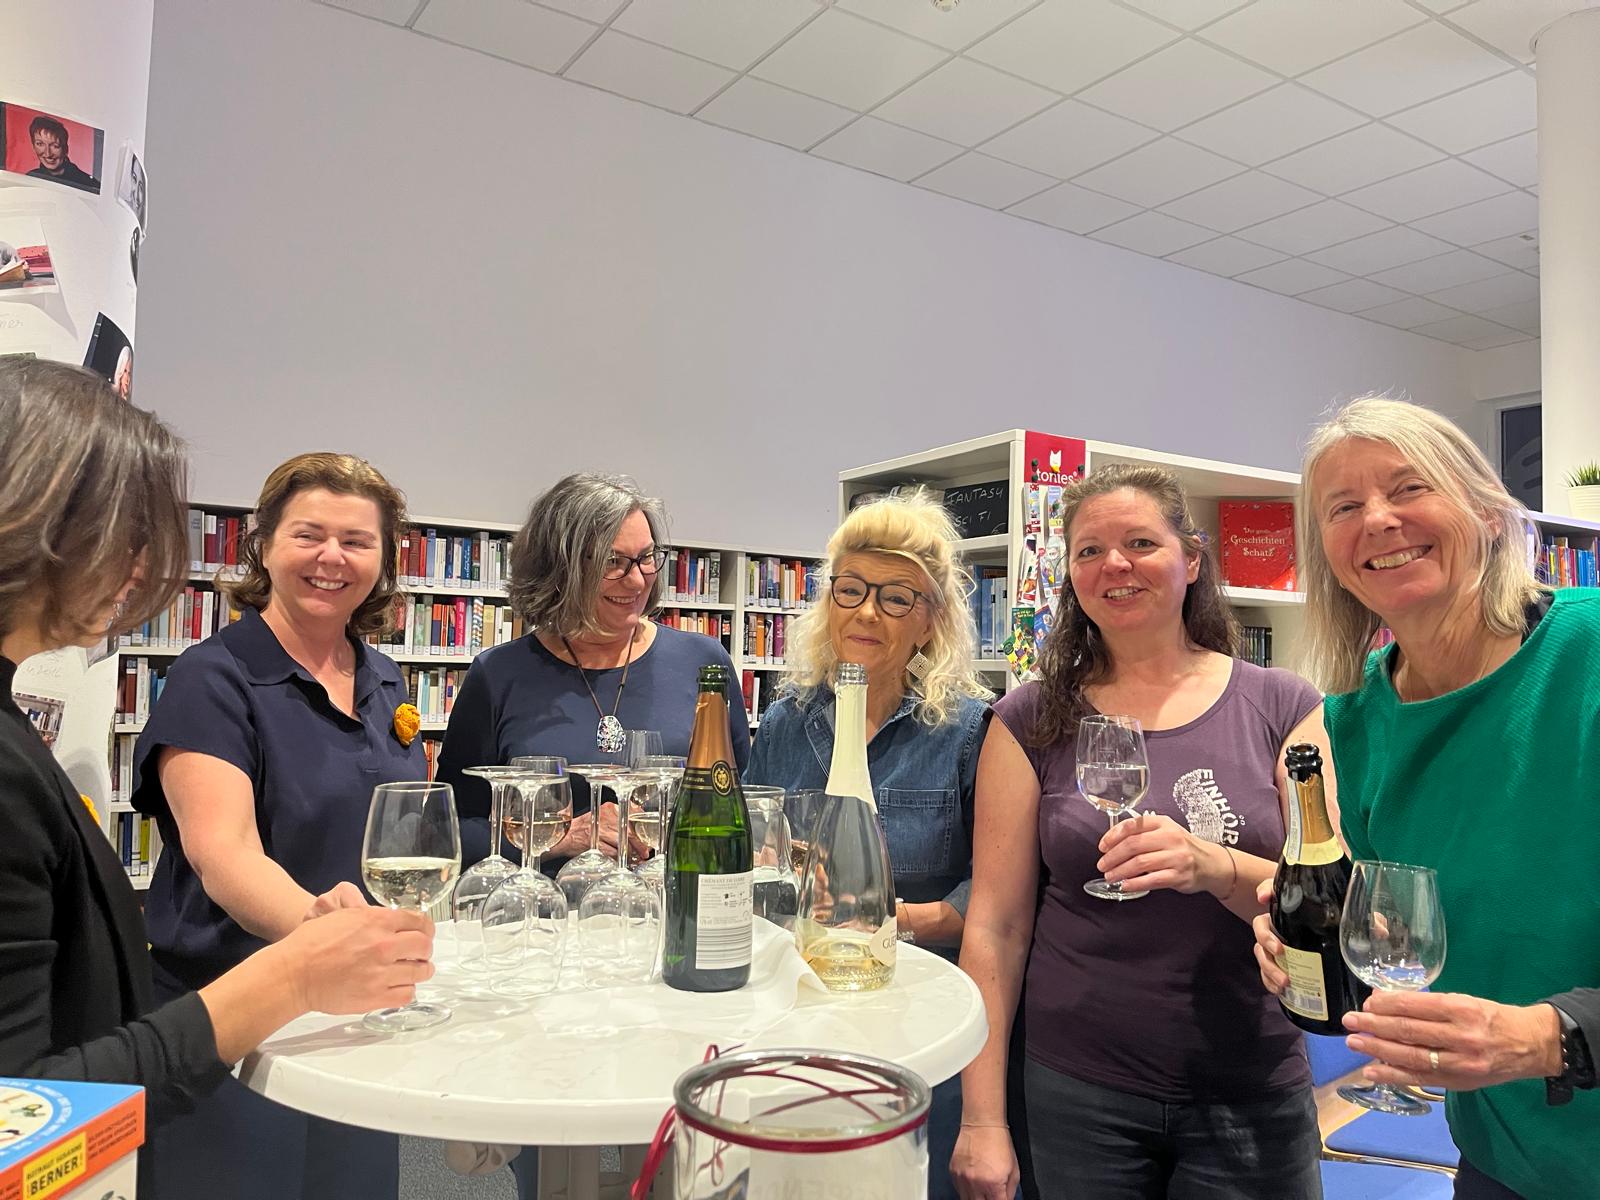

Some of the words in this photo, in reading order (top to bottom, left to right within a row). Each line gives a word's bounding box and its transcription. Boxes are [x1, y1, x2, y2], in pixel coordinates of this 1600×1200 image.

[1036, 468, 1074, 485] tonies
[1230, 534, 1286, 546] Geschichten
[1243, 547, 1276, 557] Schatz
[1200, 768, 1246, 845] EINHÖR
[30, 1155, 79, 1196] BERNER
